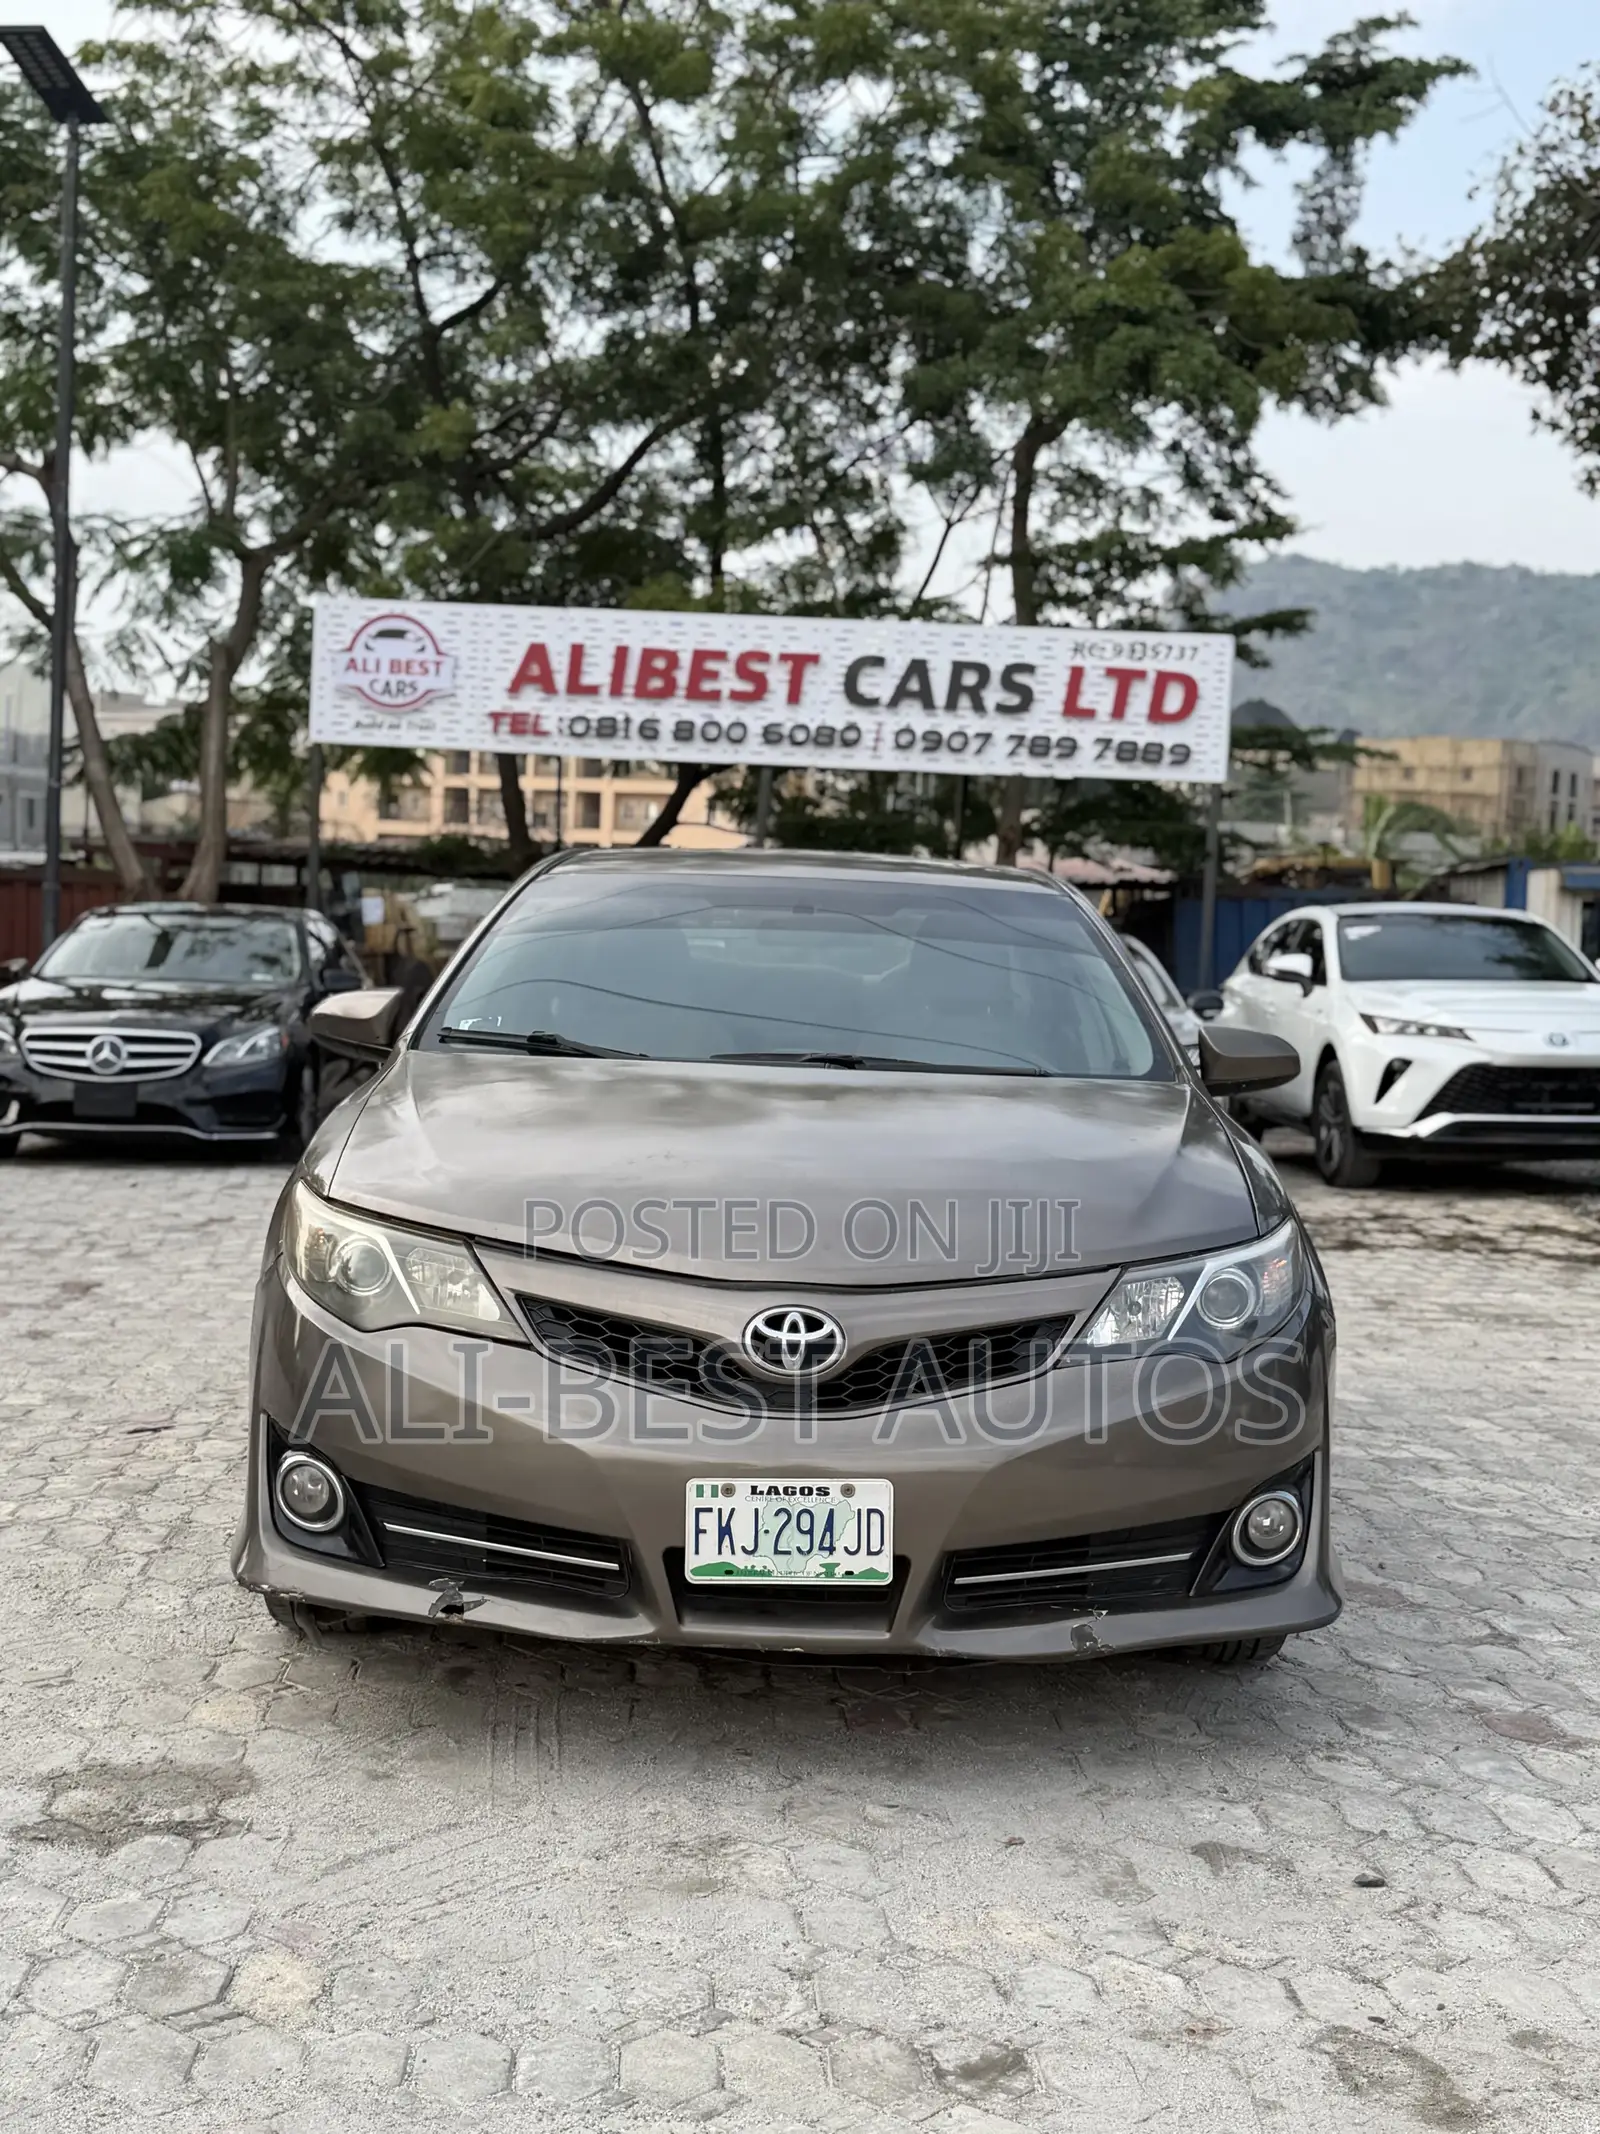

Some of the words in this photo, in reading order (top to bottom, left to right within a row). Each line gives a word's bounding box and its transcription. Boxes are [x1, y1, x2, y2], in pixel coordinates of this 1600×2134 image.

[345, 657, 380, 674] ALI
[389, 659, 443, 677] BEST
[369, 679, 418, 698] CARS
[507, 642, 821, 707] ALIBEST
[843, 654, 1037, 714] CARS
[1061, 665, 1199, 724] LTD
[672, 718, 748, 744] 800
[761, 722, 862, 748] 6080
[893, 730, 994, 756] 0907
[1007, 734, 1078, 759] 789
[1093, 737, 1192, 766] 7889
[750, 1485, 831, 1497] LAGOS
